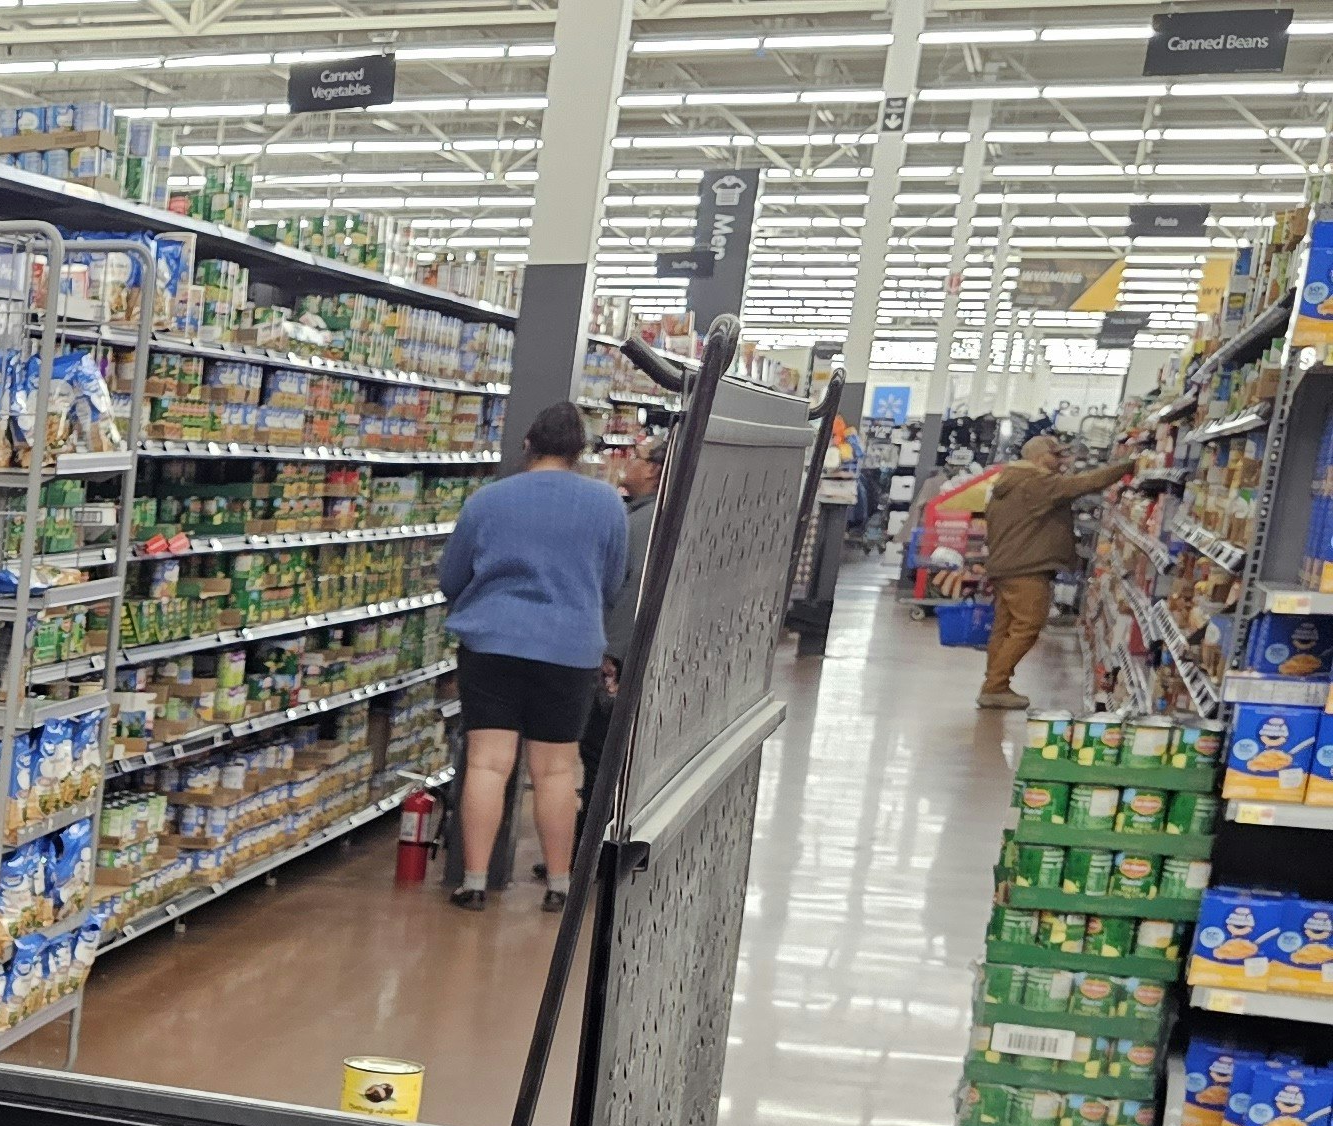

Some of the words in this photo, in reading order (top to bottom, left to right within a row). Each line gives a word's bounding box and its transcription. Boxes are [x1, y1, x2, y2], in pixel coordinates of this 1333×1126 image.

[1168, 34, 1224, 51] Canned
[1226, 33, 1269, 49] Beans
[321, 67, 365, 83] Canned
[312, 83, 372, 101] Vegetables
[1021, 271, 1083, 284] WYOMING
